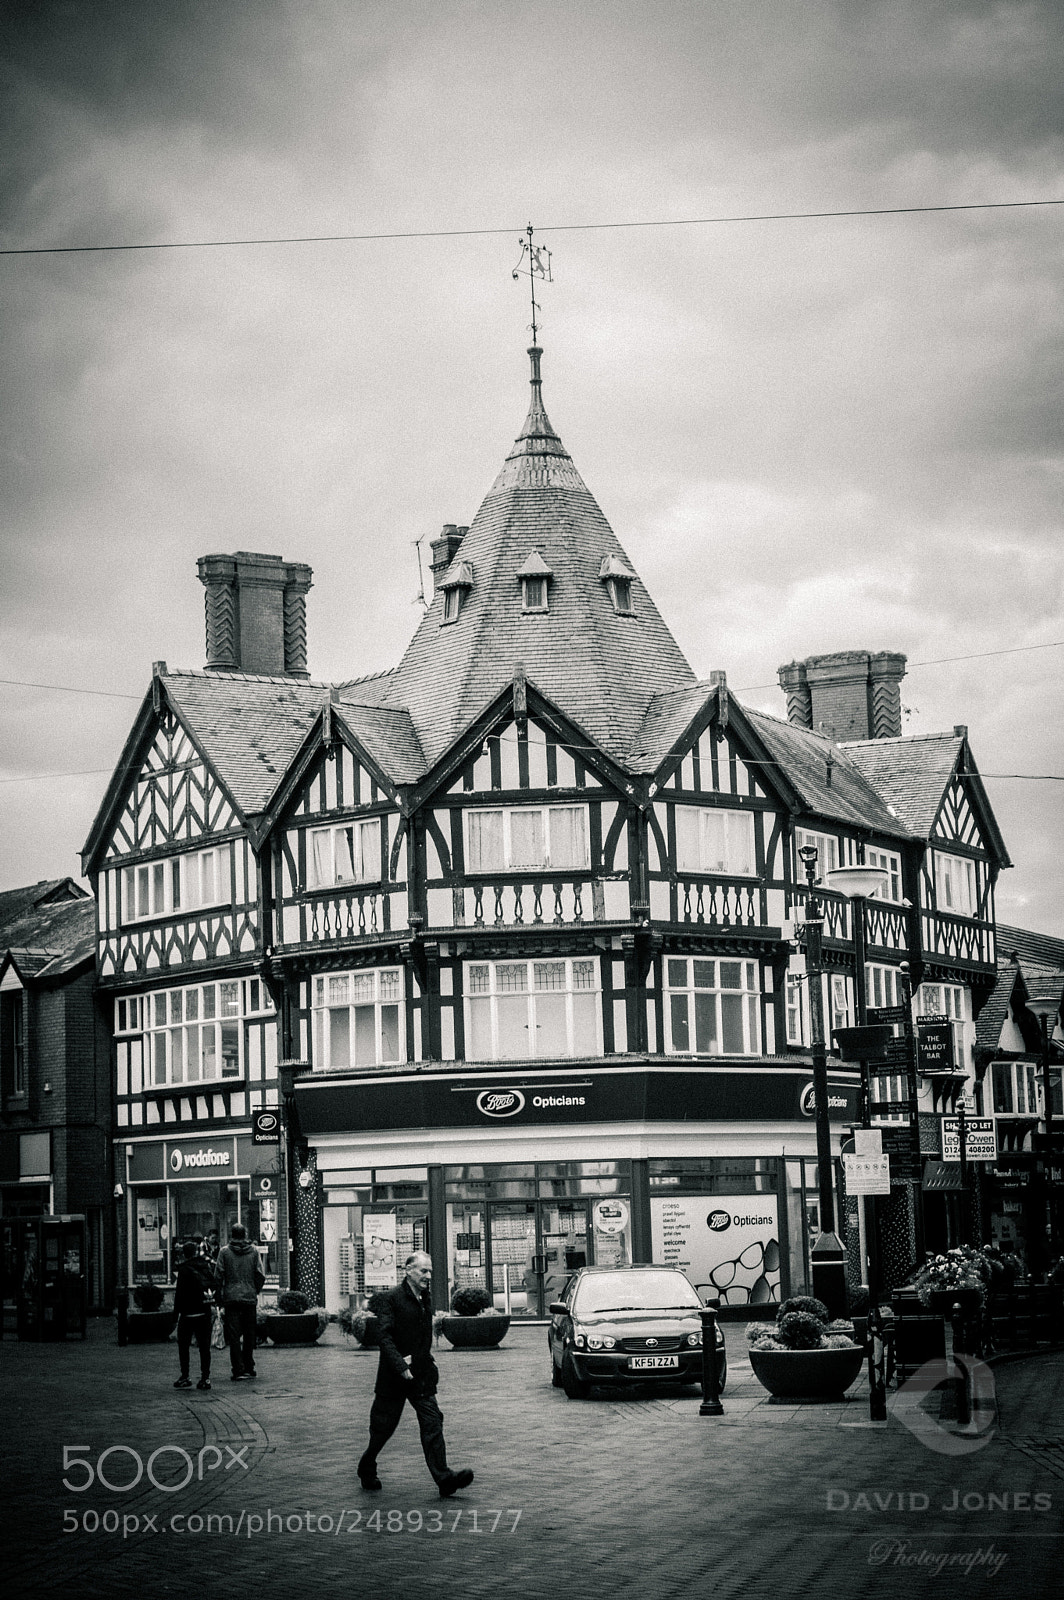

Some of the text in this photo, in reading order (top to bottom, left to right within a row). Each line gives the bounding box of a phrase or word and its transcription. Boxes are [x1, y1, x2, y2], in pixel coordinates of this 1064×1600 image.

[920, 1043, 947, 1051] TALBOT
[484, 1094, 586, 1111] Boots Opticians
[827, 1095, 848, 1108] pticians
[968, 1134, 995, 1143] Owen
[184, 1149, 230, 1167] vodafone
[733, 1215, 773, 1228] Opticians
[634, 1357, 675, 1367] KF51 ZZA
